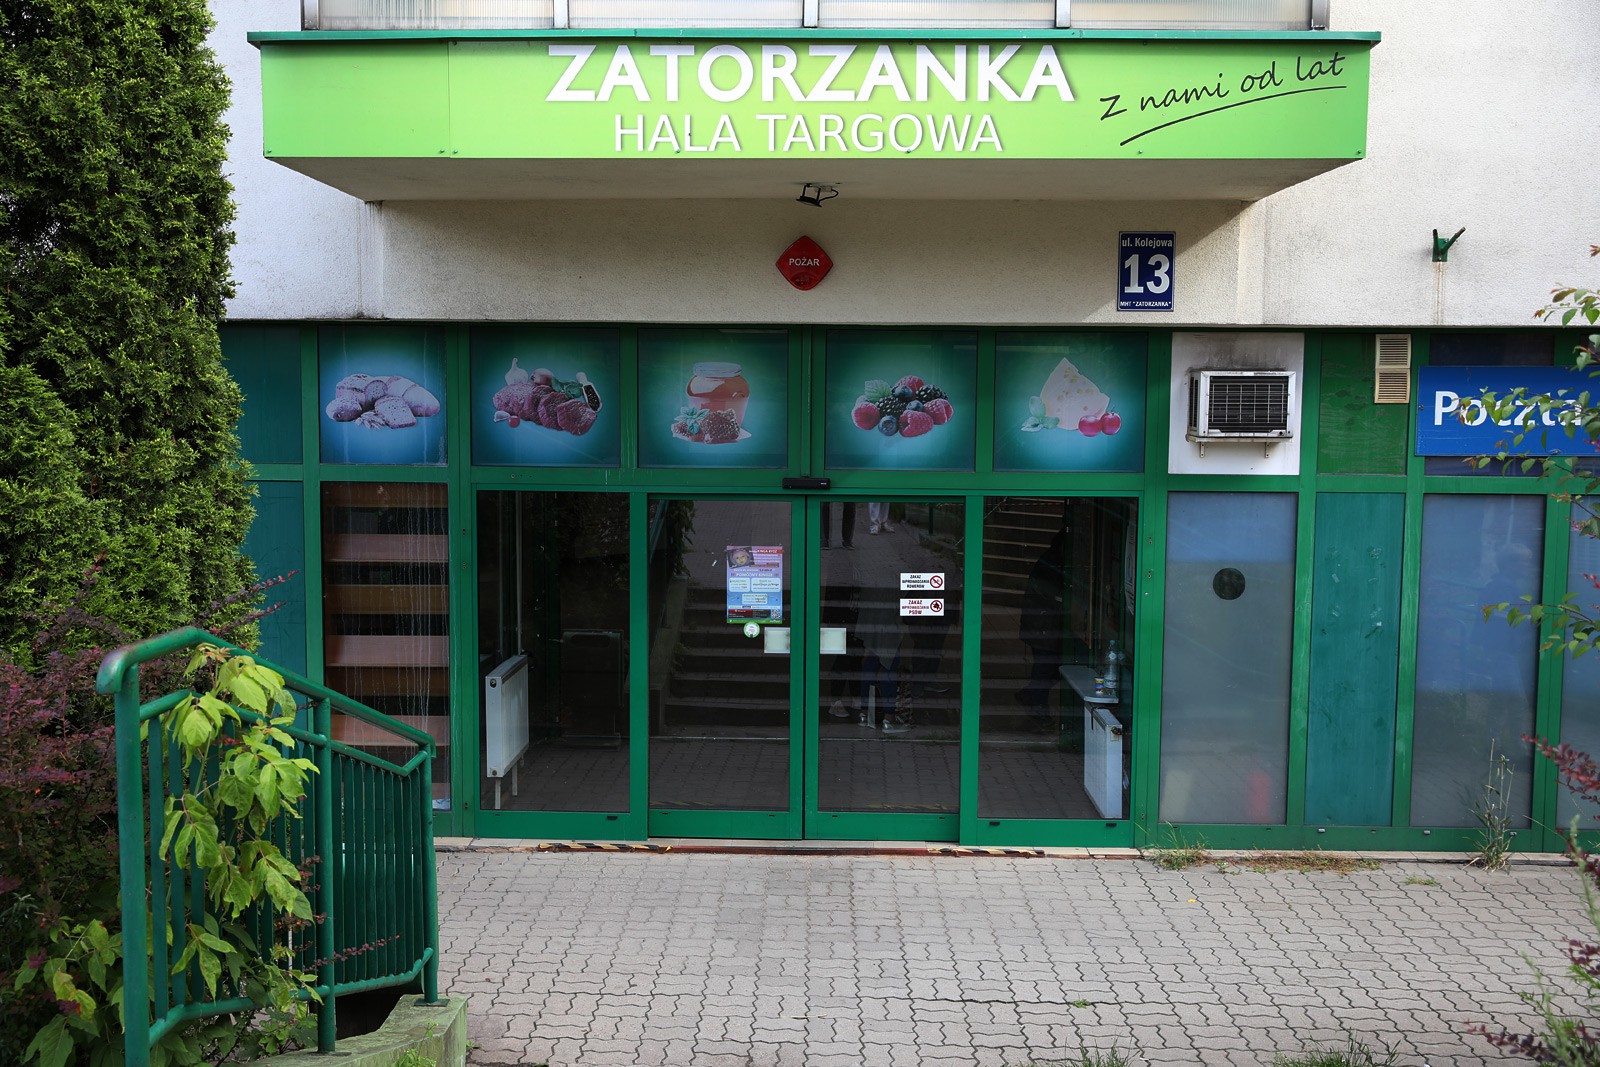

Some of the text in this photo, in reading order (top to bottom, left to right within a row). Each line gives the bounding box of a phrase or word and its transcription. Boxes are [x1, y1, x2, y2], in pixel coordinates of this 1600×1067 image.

[545, 44, 1075, 102] ZATORZANKA
[1140, 72, 1230, 111] nami
[1240, 60, 1284, 93] od
[1296, 52, 1346, 82] lat
[615, 113, 1004, 152] HALA TARGOWA
[788, 257, 820, 267] POŻAR
[1122, 237, 1173, 249] ul. Kolejowa
[1124, 253, 1170, 294] 13
